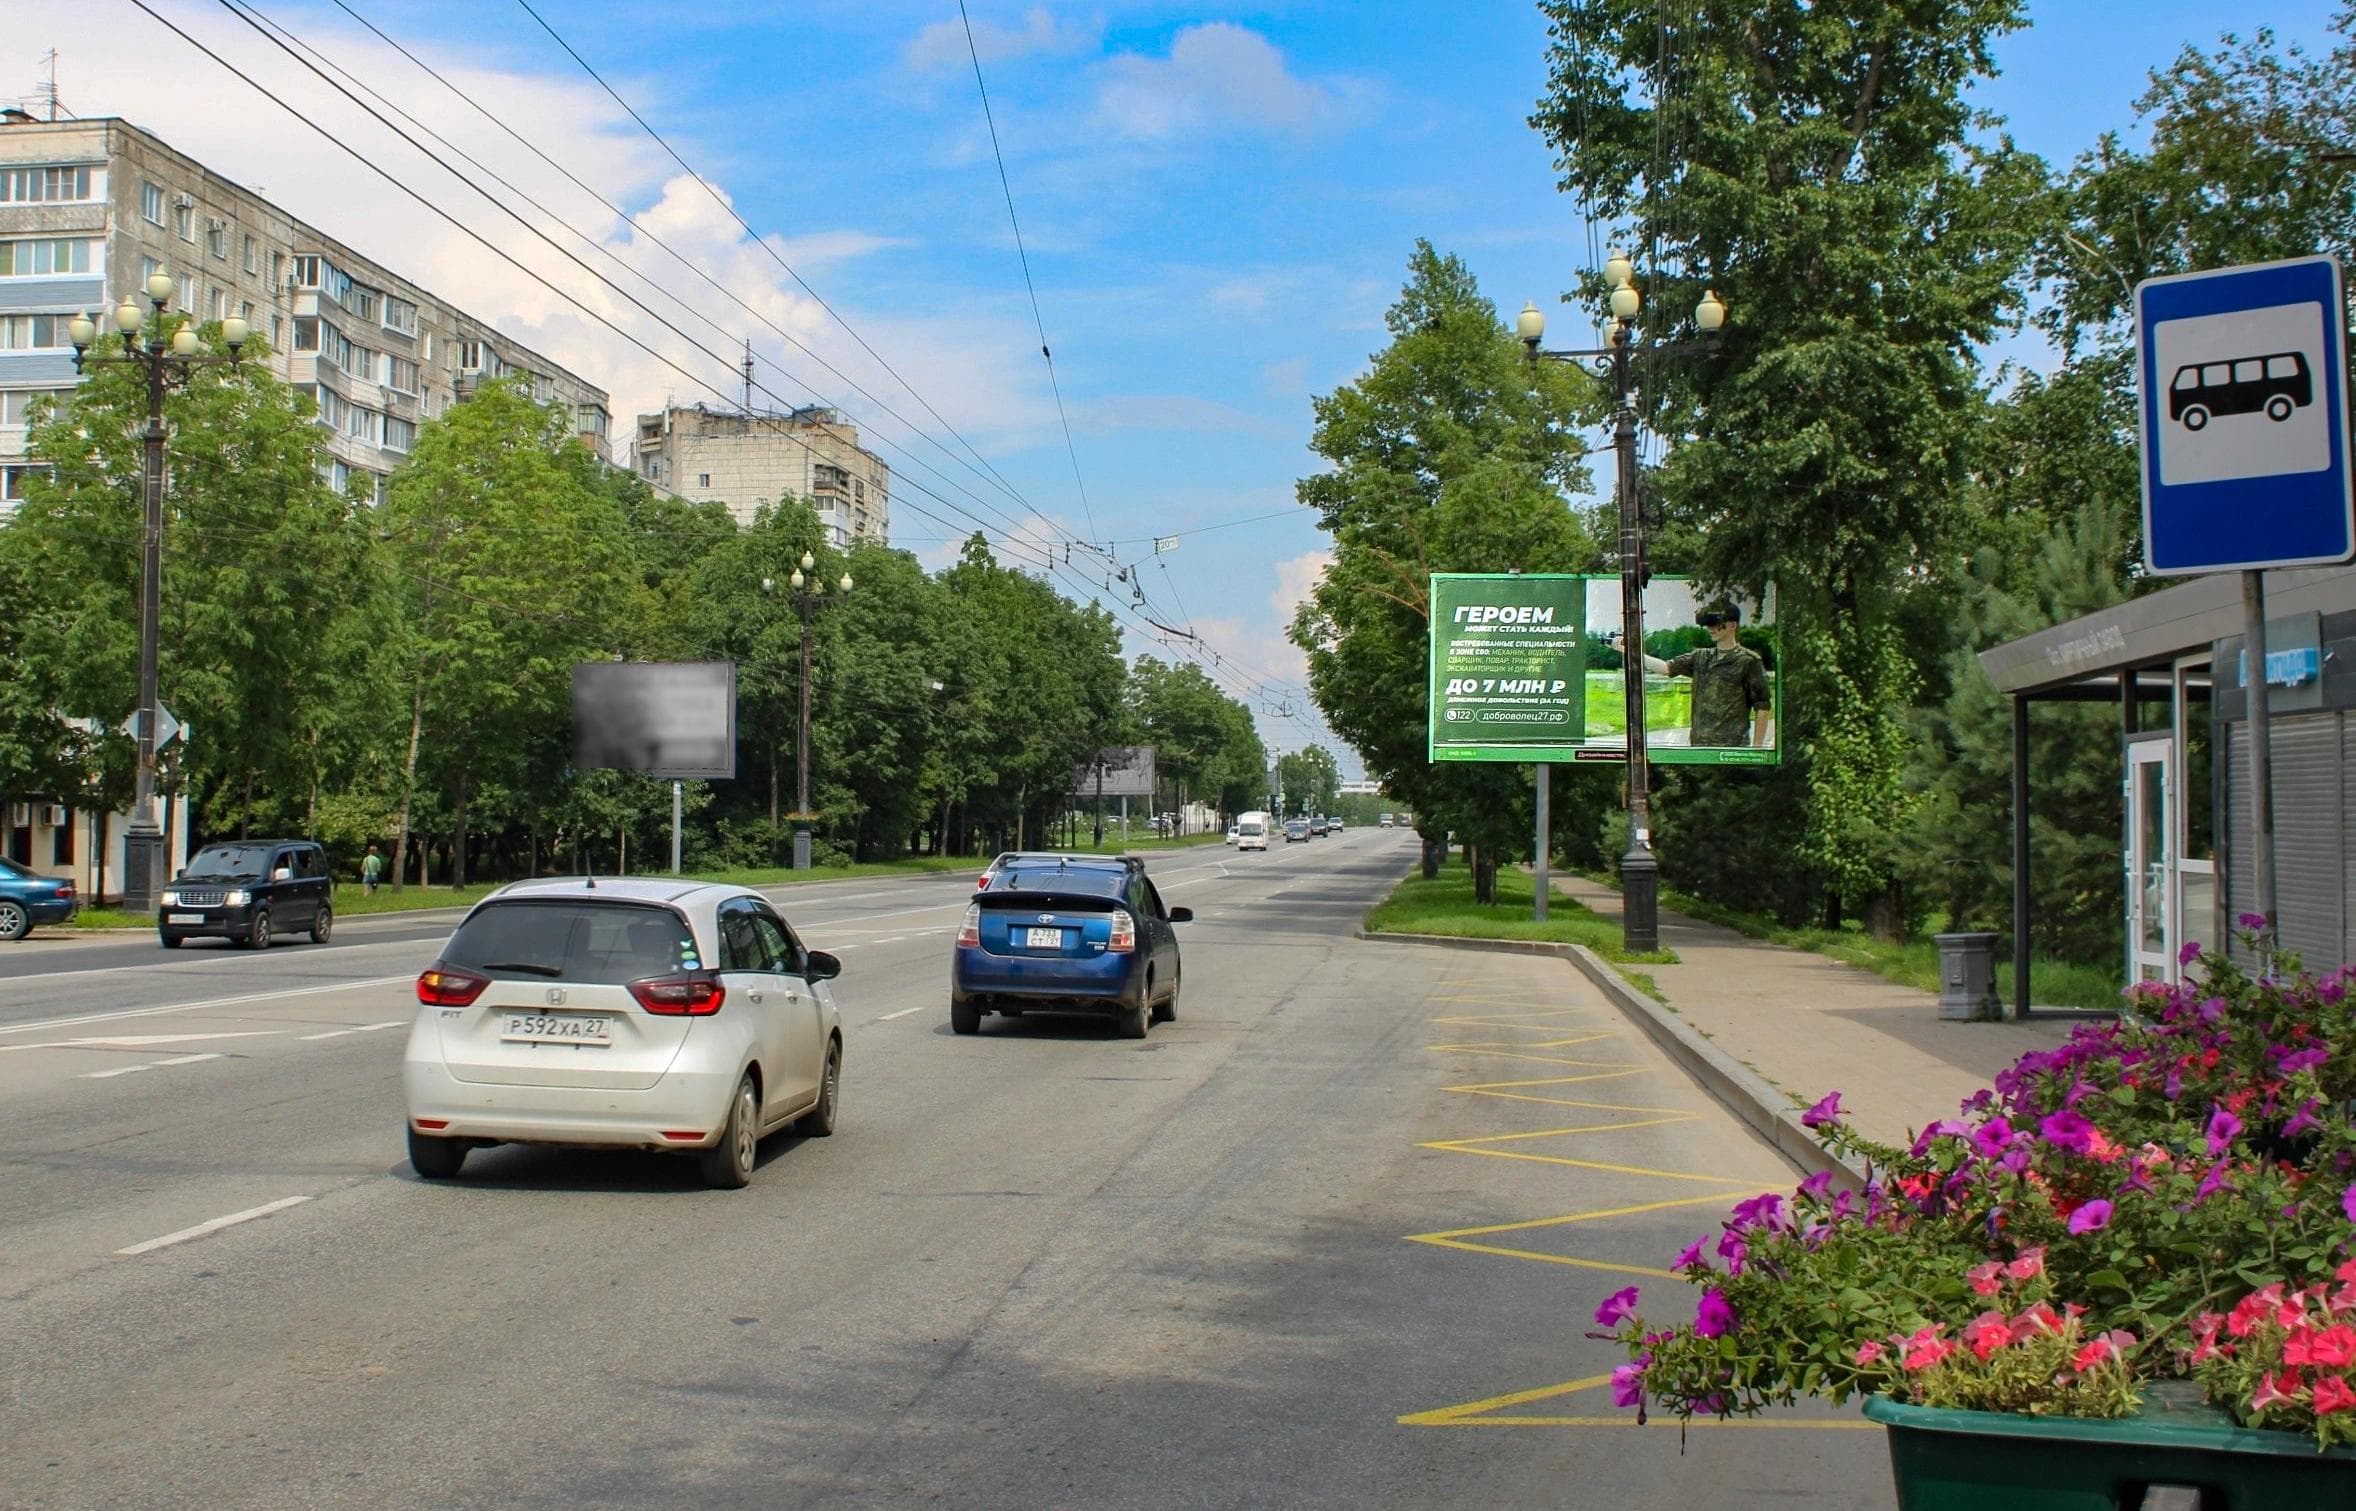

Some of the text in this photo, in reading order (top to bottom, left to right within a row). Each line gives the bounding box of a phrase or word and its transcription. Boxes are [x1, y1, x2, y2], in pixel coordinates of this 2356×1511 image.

[1454, 606, 1554, 624] ГЕРОЕМ
[1445, 679, 1478, 695] ДО
[1483, 680, 1495, 693] 7
[1500, 680, 1546, 693] МЛН
[1457, 711, 1563, 721] 122 доброволец27.рф
[441, 1011, 462, 1019] FIT
[510, 1016, 605, 1037] Р592ХА 27
